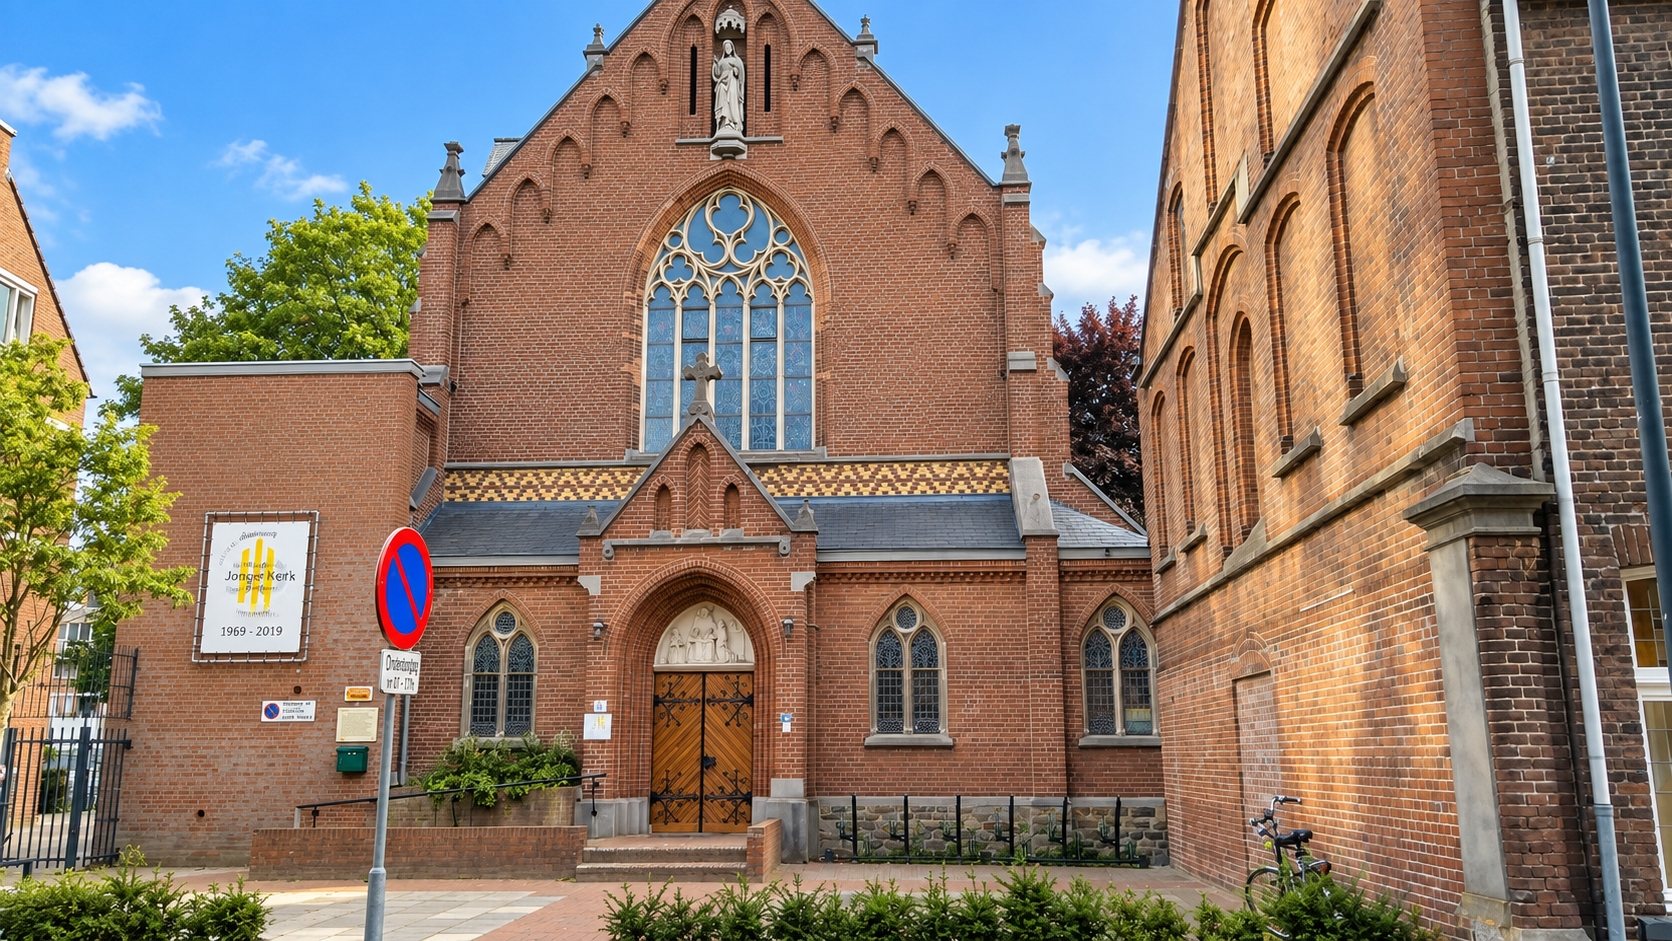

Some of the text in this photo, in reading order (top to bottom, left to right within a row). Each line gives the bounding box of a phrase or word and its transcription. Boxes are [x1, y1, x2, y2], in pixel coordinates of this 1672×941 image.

[267, 570, 296, 581] Kerk
[220, 626, 246, 637] 1969
[256, 625, 283, 637] 2019
